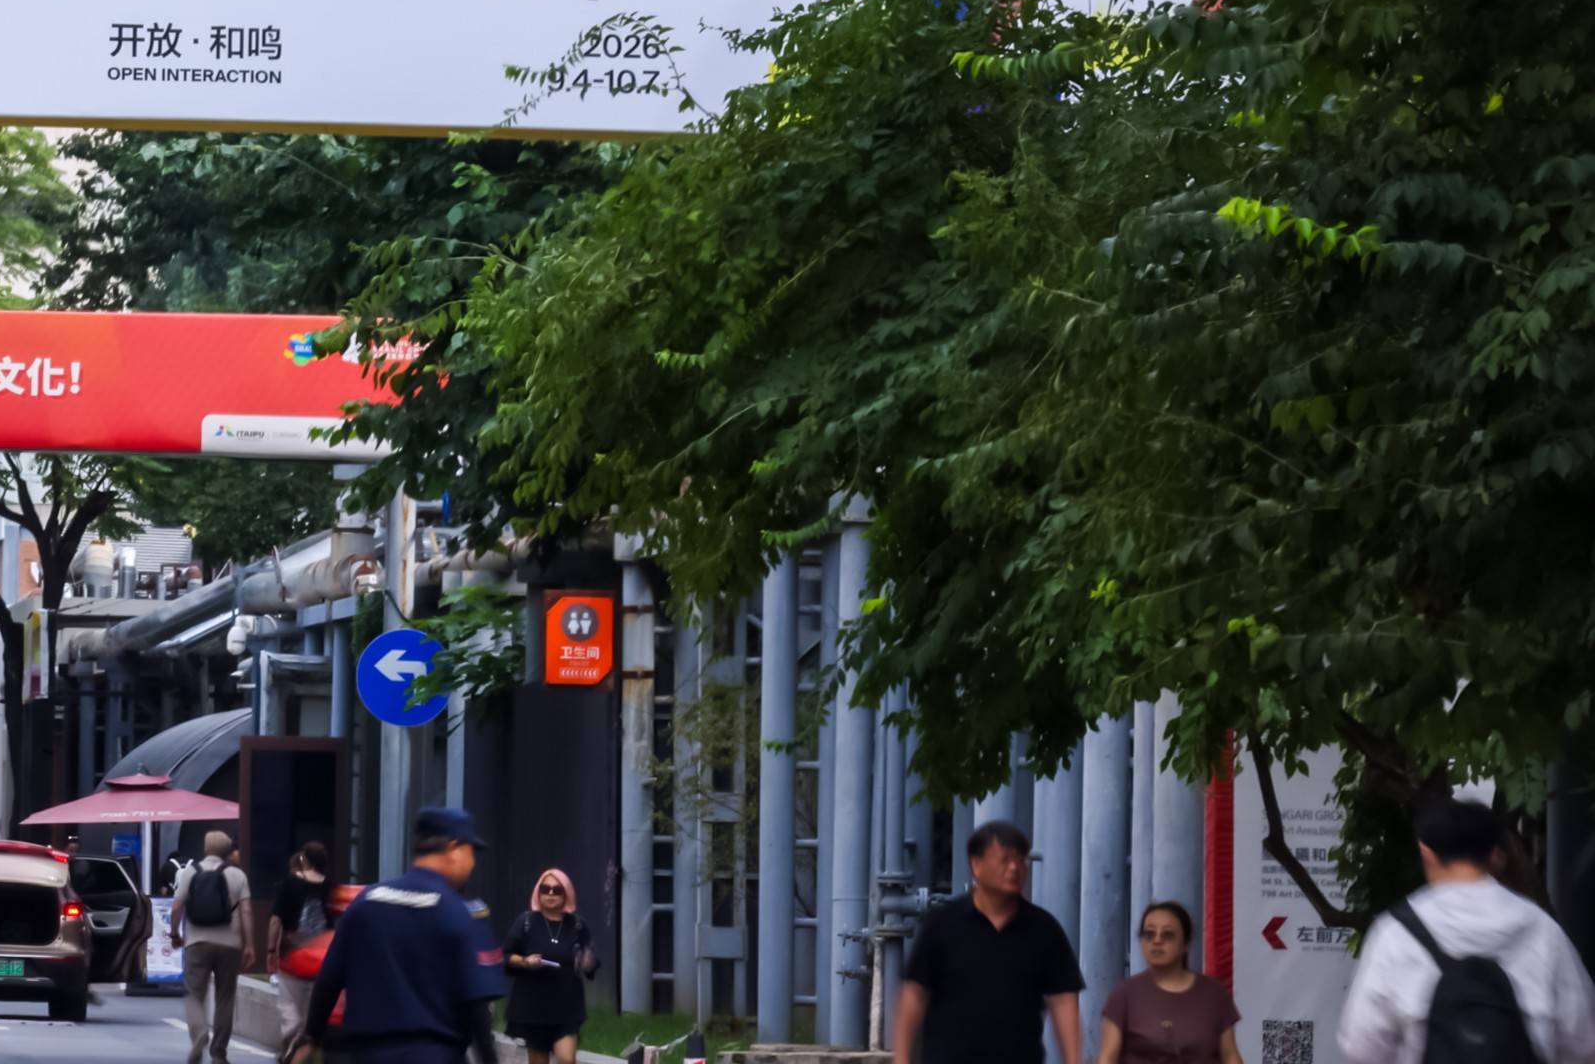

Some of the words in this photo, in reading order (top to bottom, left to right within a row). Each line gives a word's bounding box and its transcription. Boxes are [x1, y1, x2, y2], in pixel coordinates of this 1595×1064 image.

[582, 33, 661, 59] 2026
[107, 67, 157, 81] OPEN
[161, 68, 282, 84] INTERACTION
[560, 646, 600, 660] 卫生间
